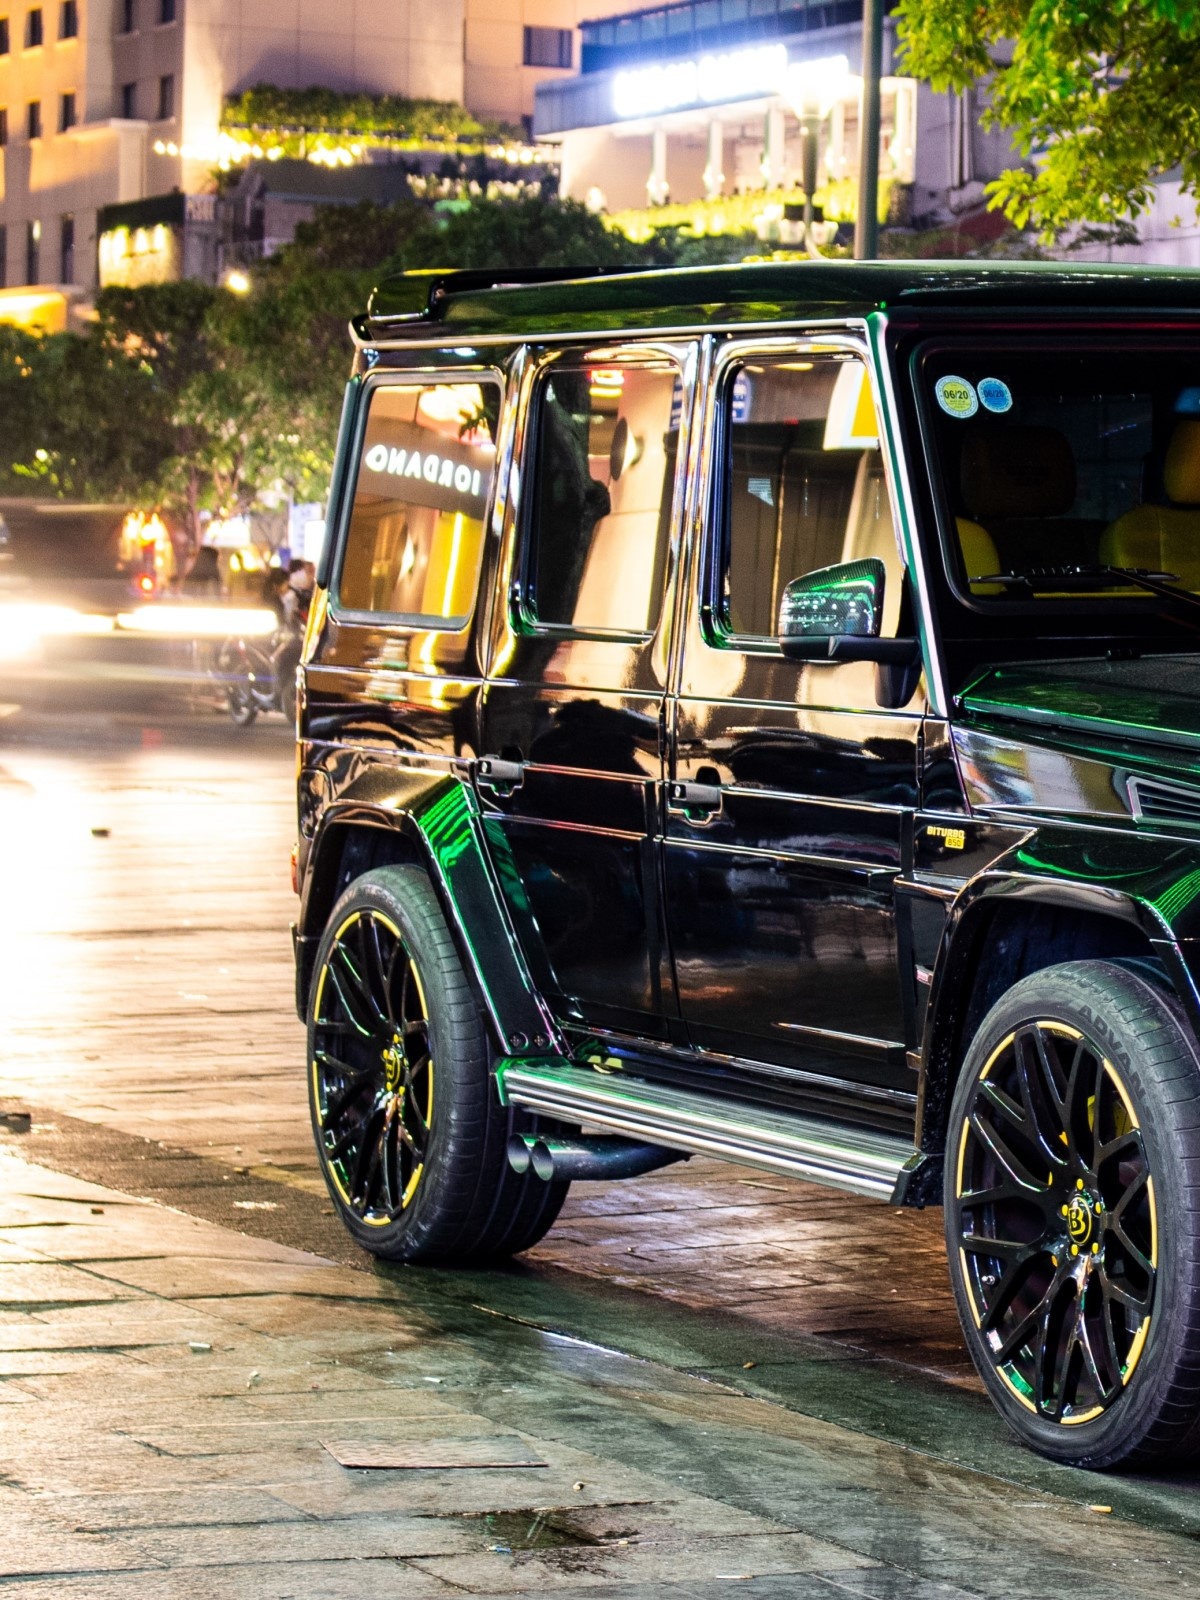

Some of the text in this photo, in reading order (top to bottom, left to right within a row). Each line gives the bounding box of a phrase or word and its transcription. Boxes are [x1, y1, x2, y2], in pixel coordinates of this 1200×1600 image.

[943, 389, 969, 400] 06/20
[983, 389, 1005, 398] 06/20
[926, 825, 966, 839] BITURBO
[947, 838, 961, 847] 850
[1078, 1004, 1147, 1099] ADVAN
[1068, 1206, 1086, 1235] B
